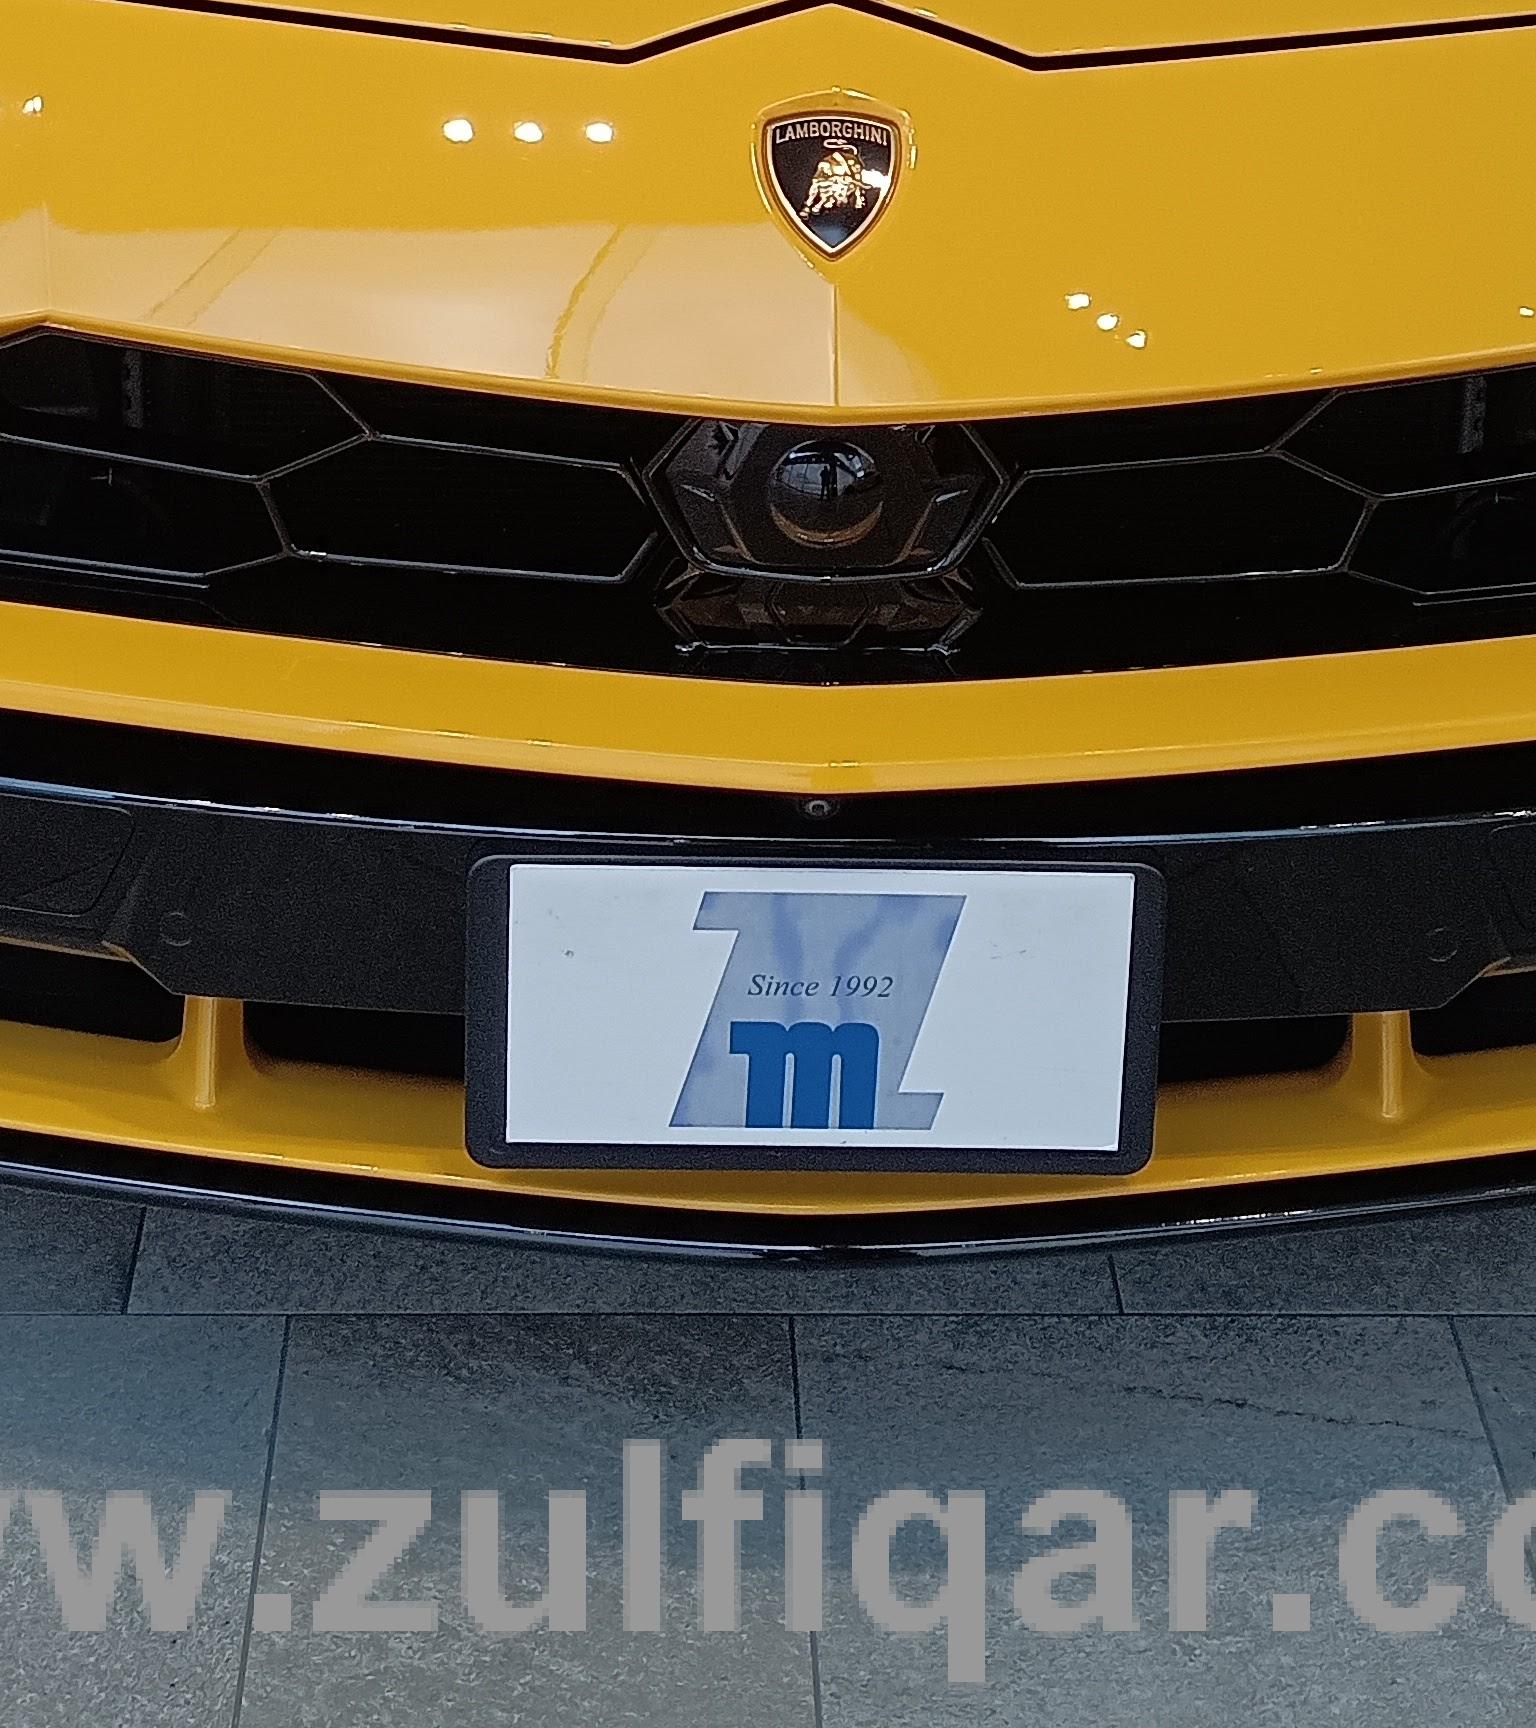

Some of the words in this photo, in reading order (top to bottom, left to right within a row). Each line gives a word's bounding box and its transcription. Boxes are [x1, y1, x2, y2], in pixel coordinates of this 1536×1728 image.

[775, 121, 888, 146] LAMBORGHINI
[747, 974, 820, 998] Since
[830, 974, 894, 999] 1992
